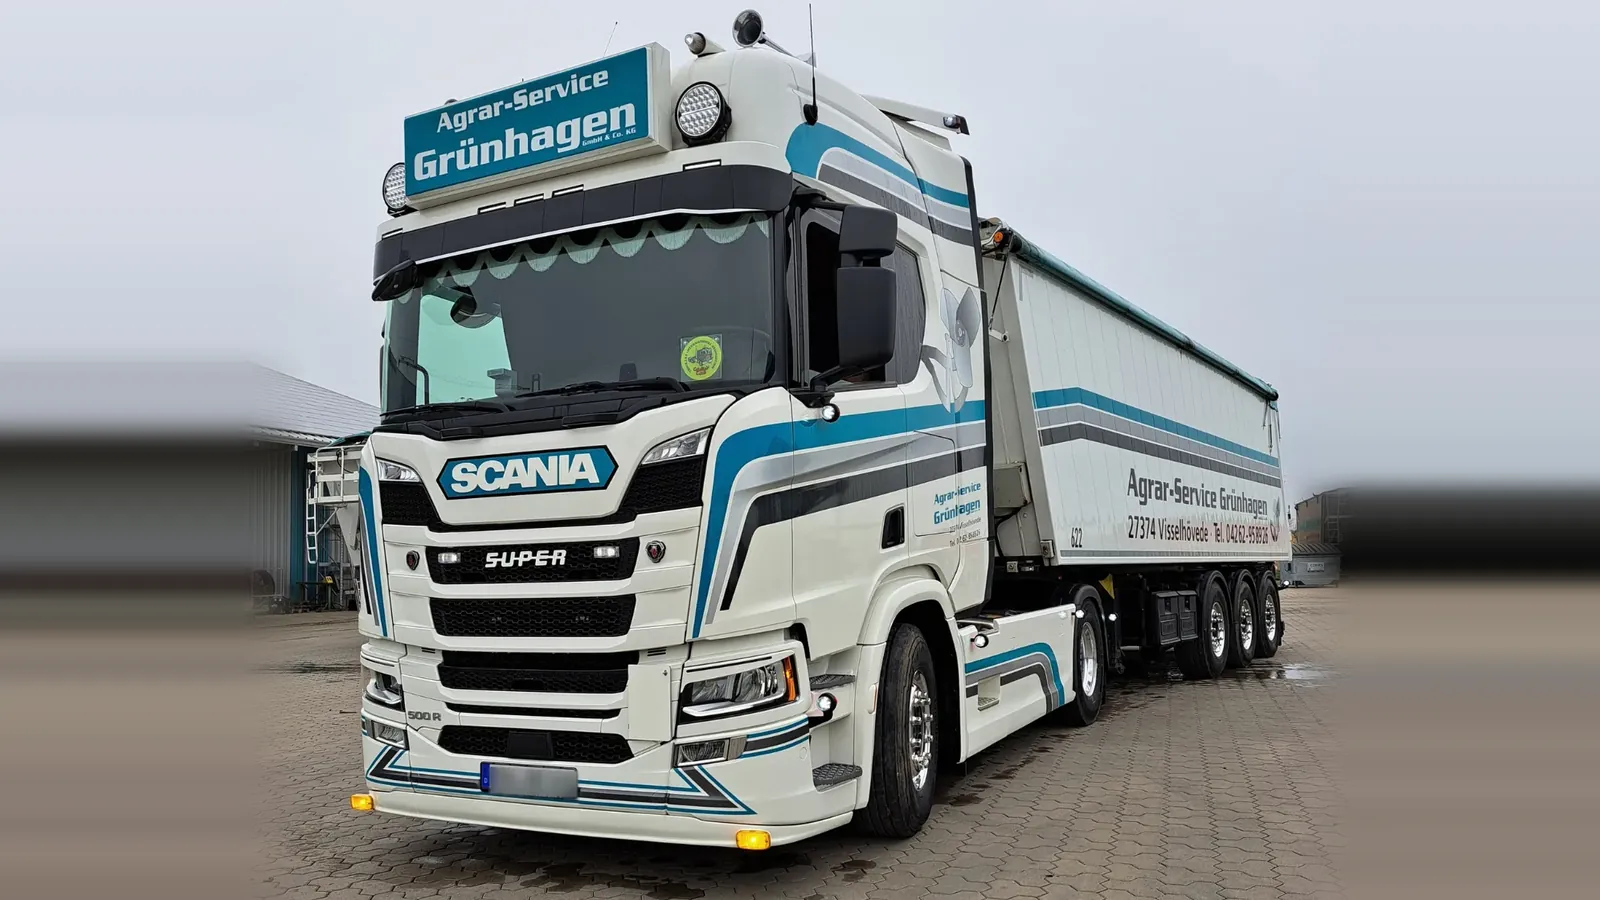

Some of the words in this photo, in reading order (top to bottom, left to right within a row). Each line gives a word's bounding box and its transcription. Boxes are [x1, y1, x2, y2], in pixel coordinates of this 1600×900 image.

[437, 69, 609, 133] Agrar-Service
[414, 102, 636, 181] Grünhagen
[582, 136, 603, 147] GmbH
[625, 126, 637, 135] KG
[450, 452, 600, 493] SCANIA
[1127, 468, 1217, 509] Agrar-Service
[1219, 487, 1268, 519] Grünhagen
[1071, 527, 1083, 548] 622
[1128, 515, 1156, 539] 27374
[1158, 517, 1209, 542] Visselhövede
[1213, 522, 1225, 543] Tel.
[485, 549, 567, 568] SUPER
[408, 711, 431, 721] 500
[432, 712, 442, 722] R
